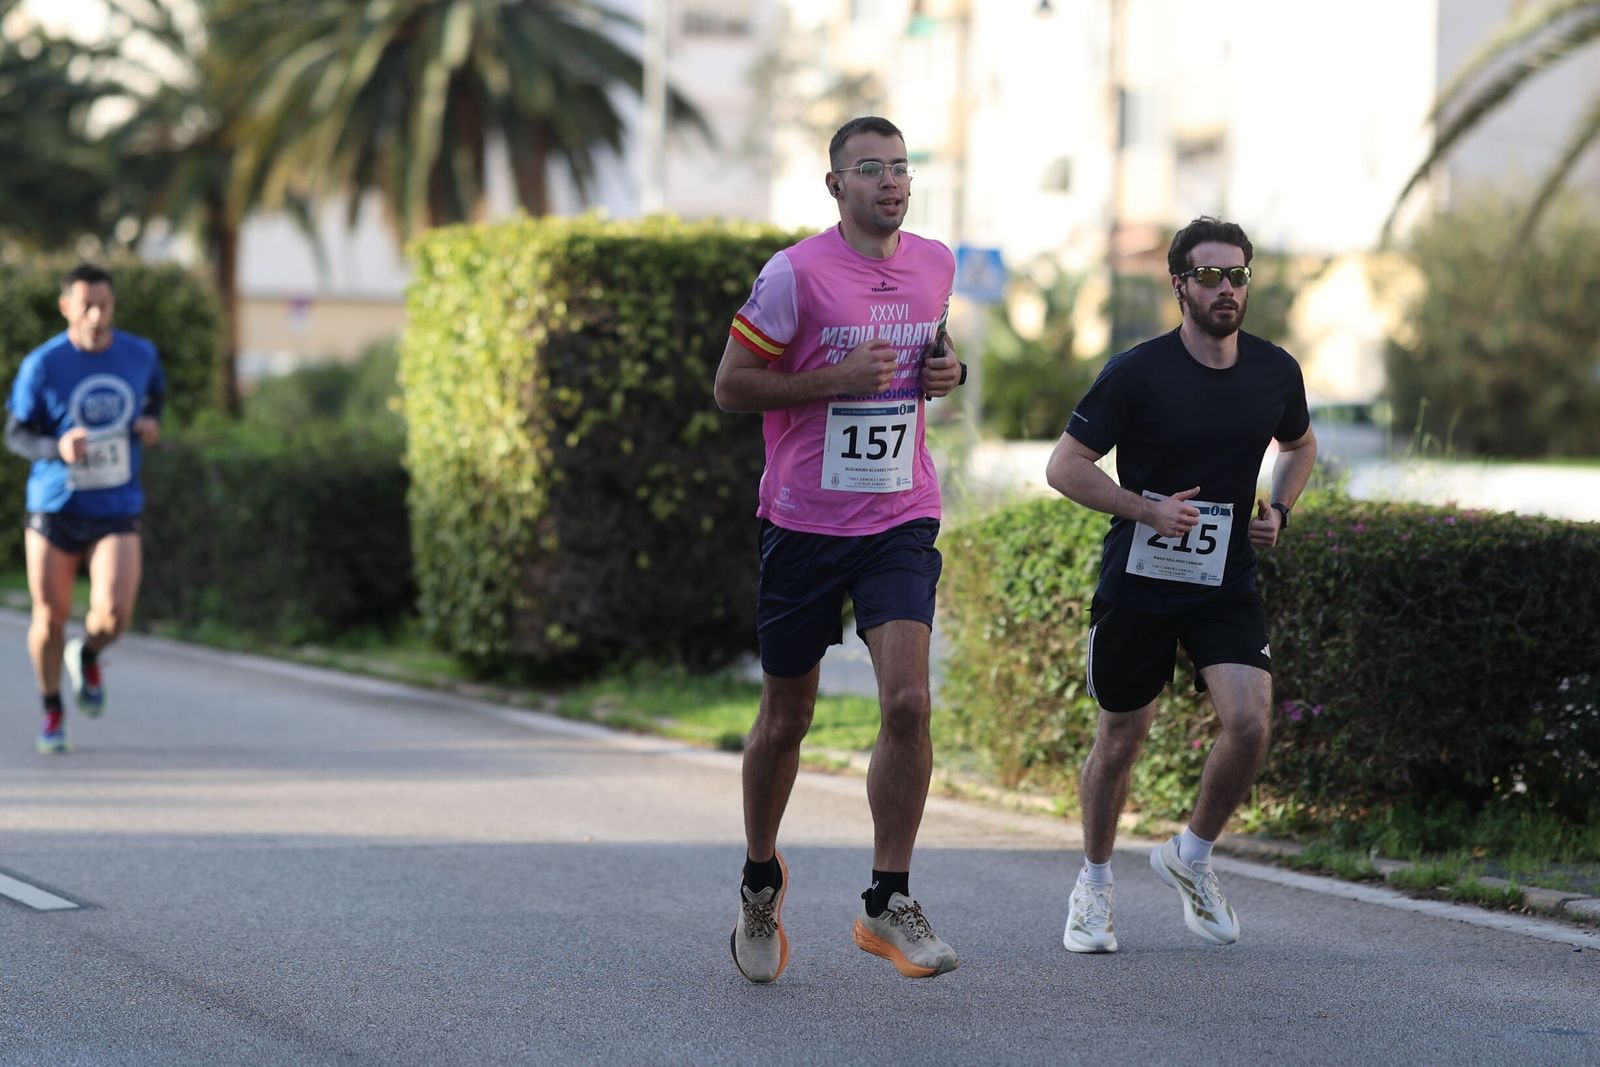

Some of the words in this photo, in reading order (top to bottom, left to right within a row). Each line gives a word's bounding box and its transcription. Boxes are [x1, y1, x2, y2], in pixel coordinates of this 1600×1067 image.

[870, 303, 909, 322] XXXVI
[820, 326, 874, 349] MEDIA
[878, 316, 940, 346] MARATÓ
[840, 423, 907, 460] 157
